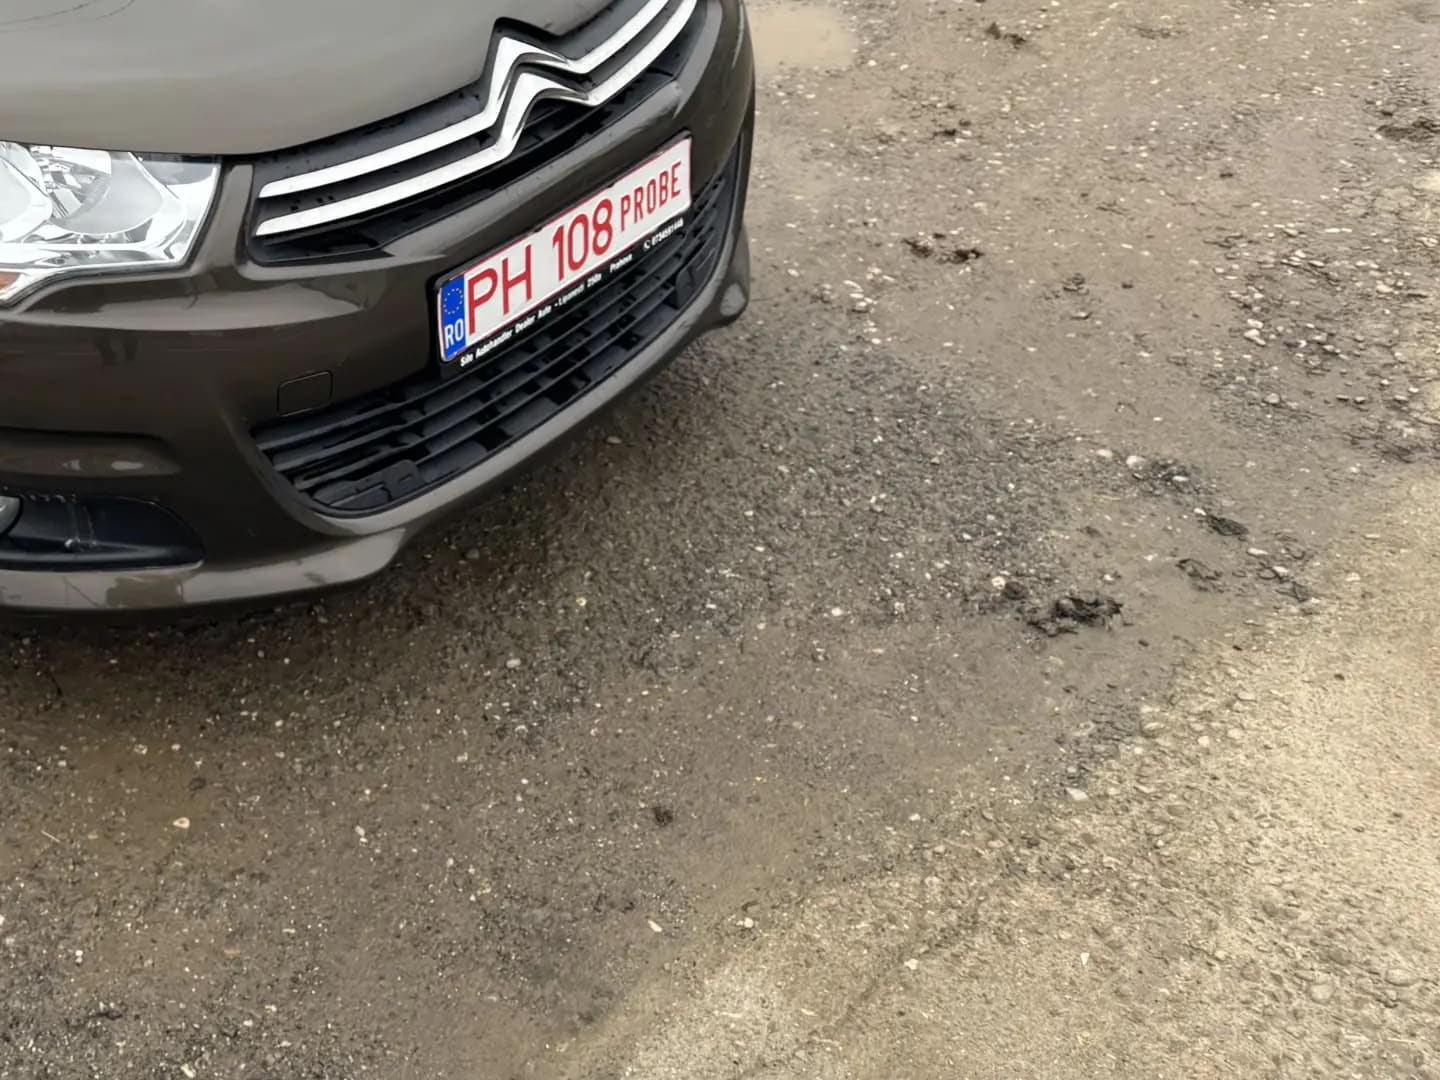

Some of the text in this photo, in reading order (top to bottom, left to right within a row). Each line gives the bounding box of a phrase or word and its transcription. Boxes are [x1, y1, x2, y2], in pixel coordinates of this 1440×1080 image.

[467, 160, 681, 336] PH 108 PROBE
[444, 318, 464, 350] RO
